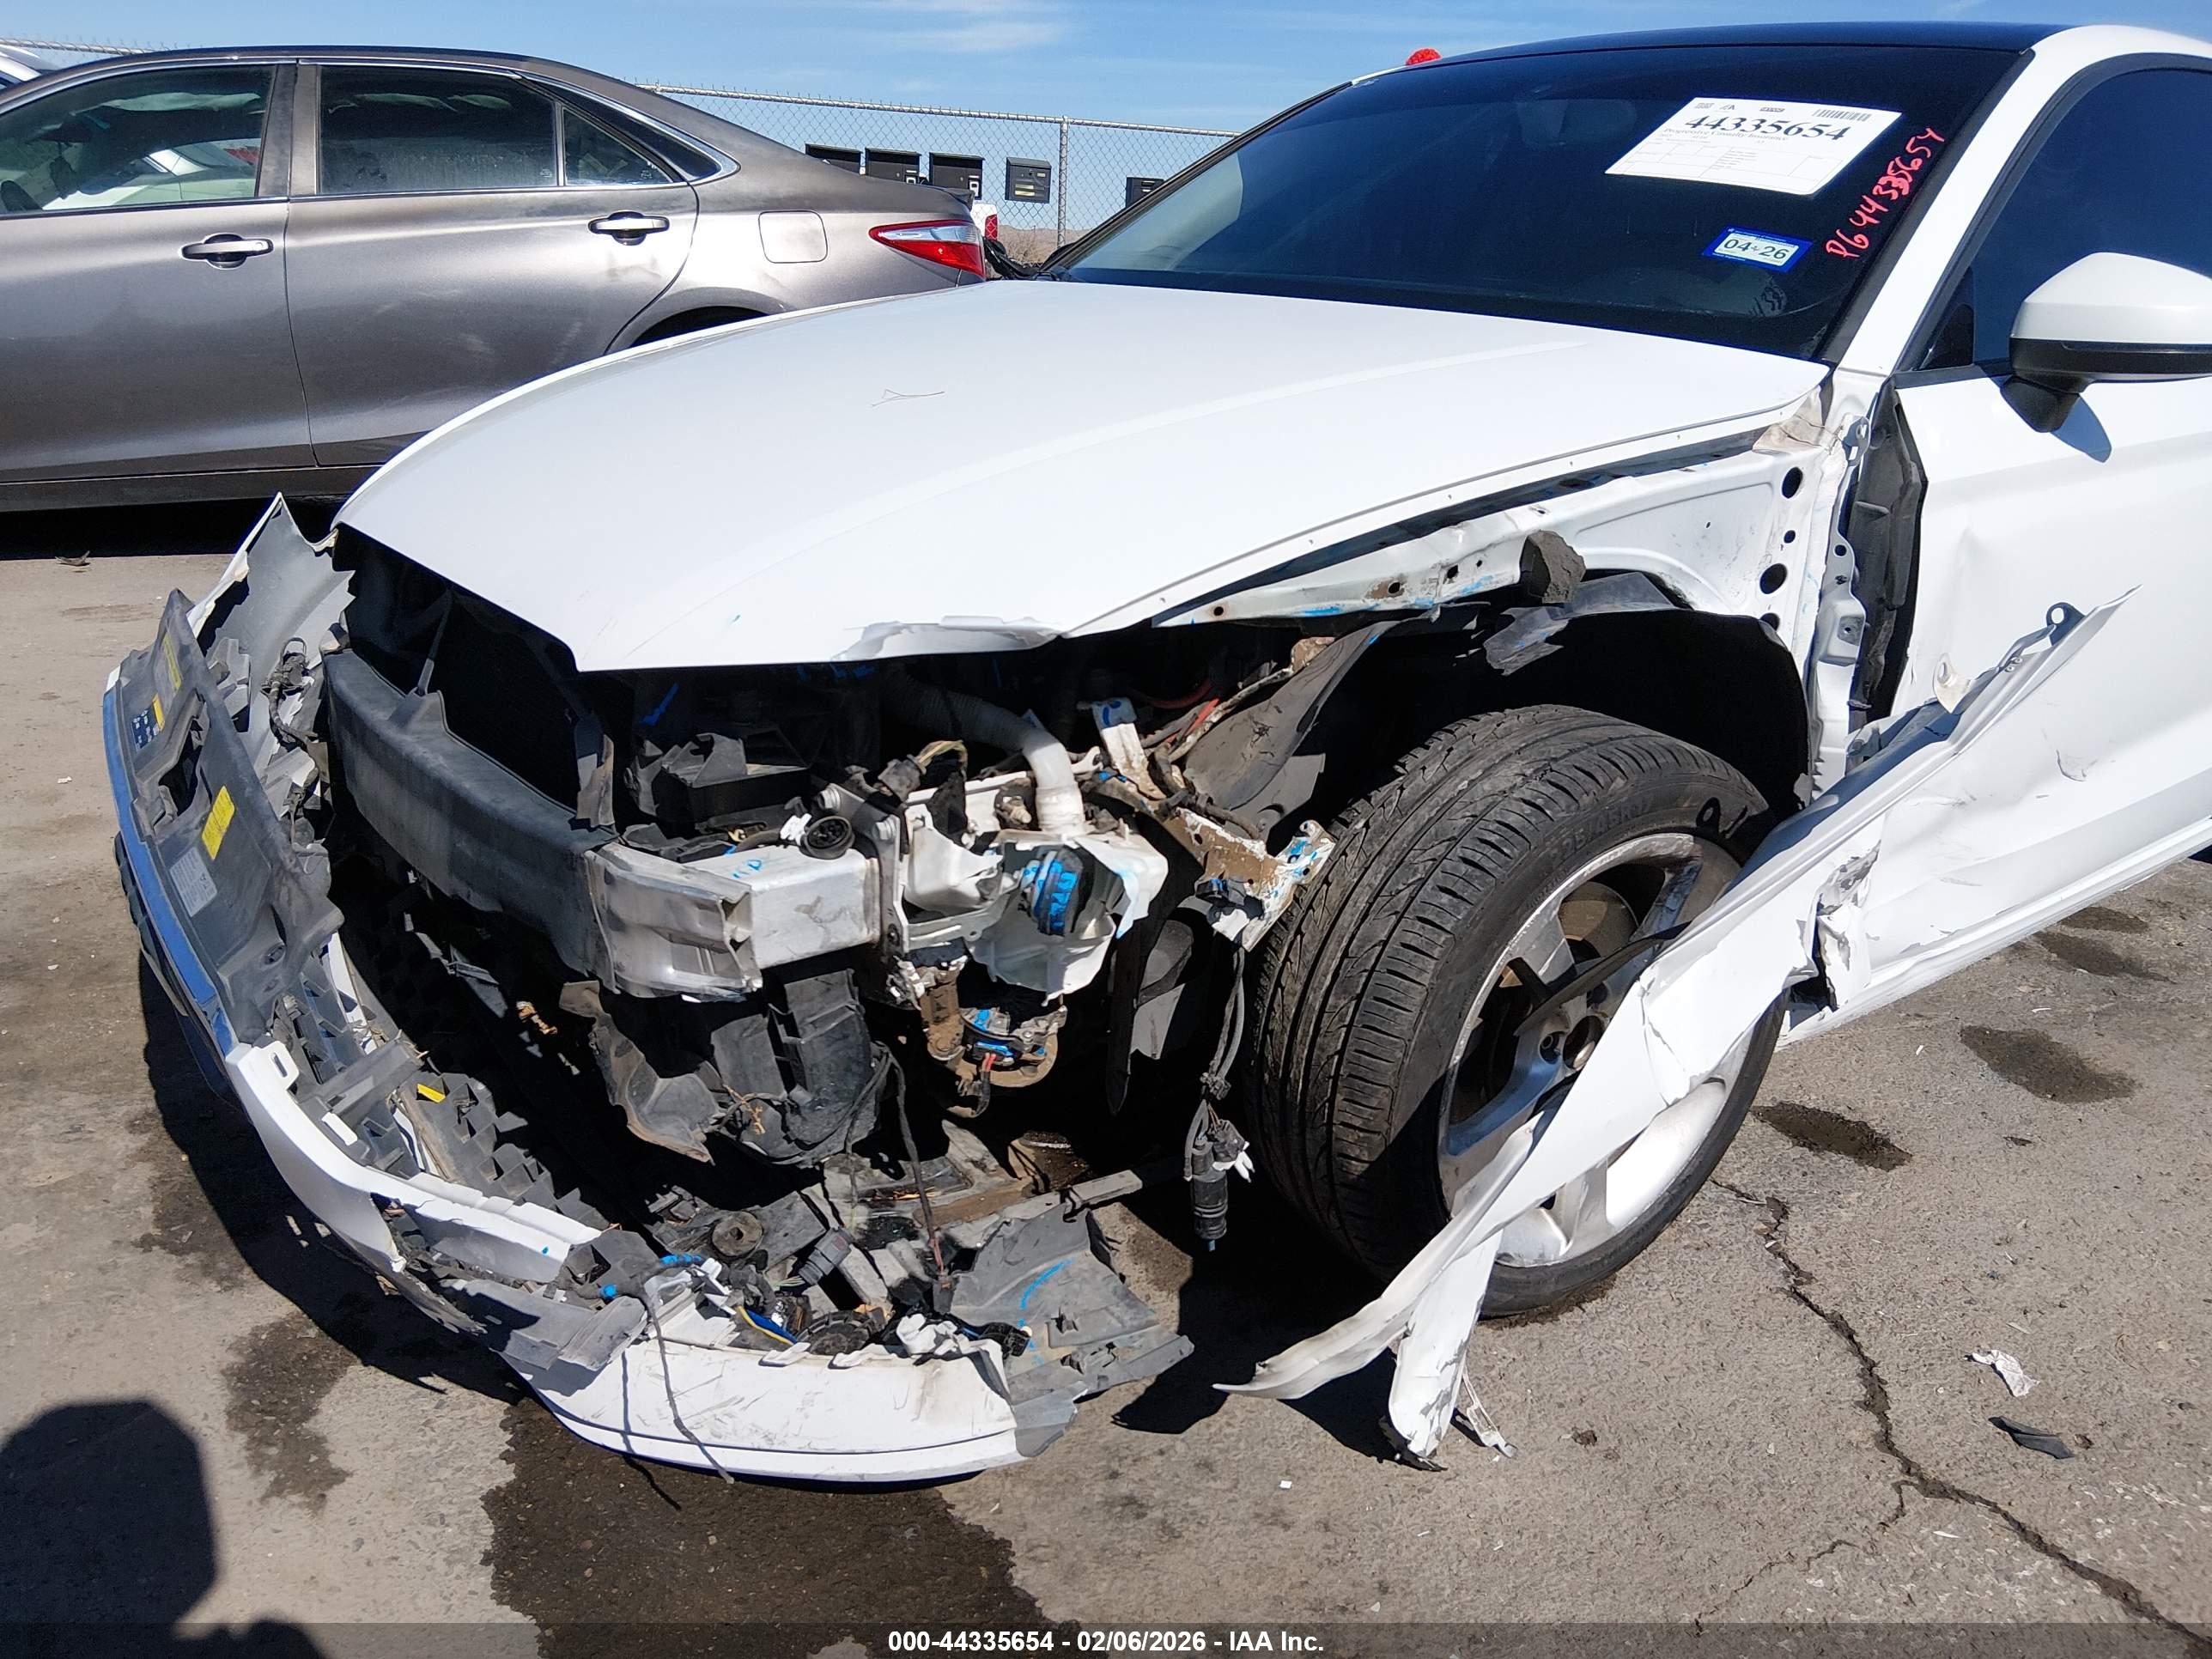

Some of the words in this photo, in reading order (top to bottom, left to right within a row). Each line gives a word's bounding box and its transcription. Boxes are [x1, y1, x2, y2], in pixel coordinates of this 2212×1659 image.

[1684, 115, 1851, 141] 44335654
[1723, 239, 1752, 252] 04
[1759, 246, 1790, 259] 26
